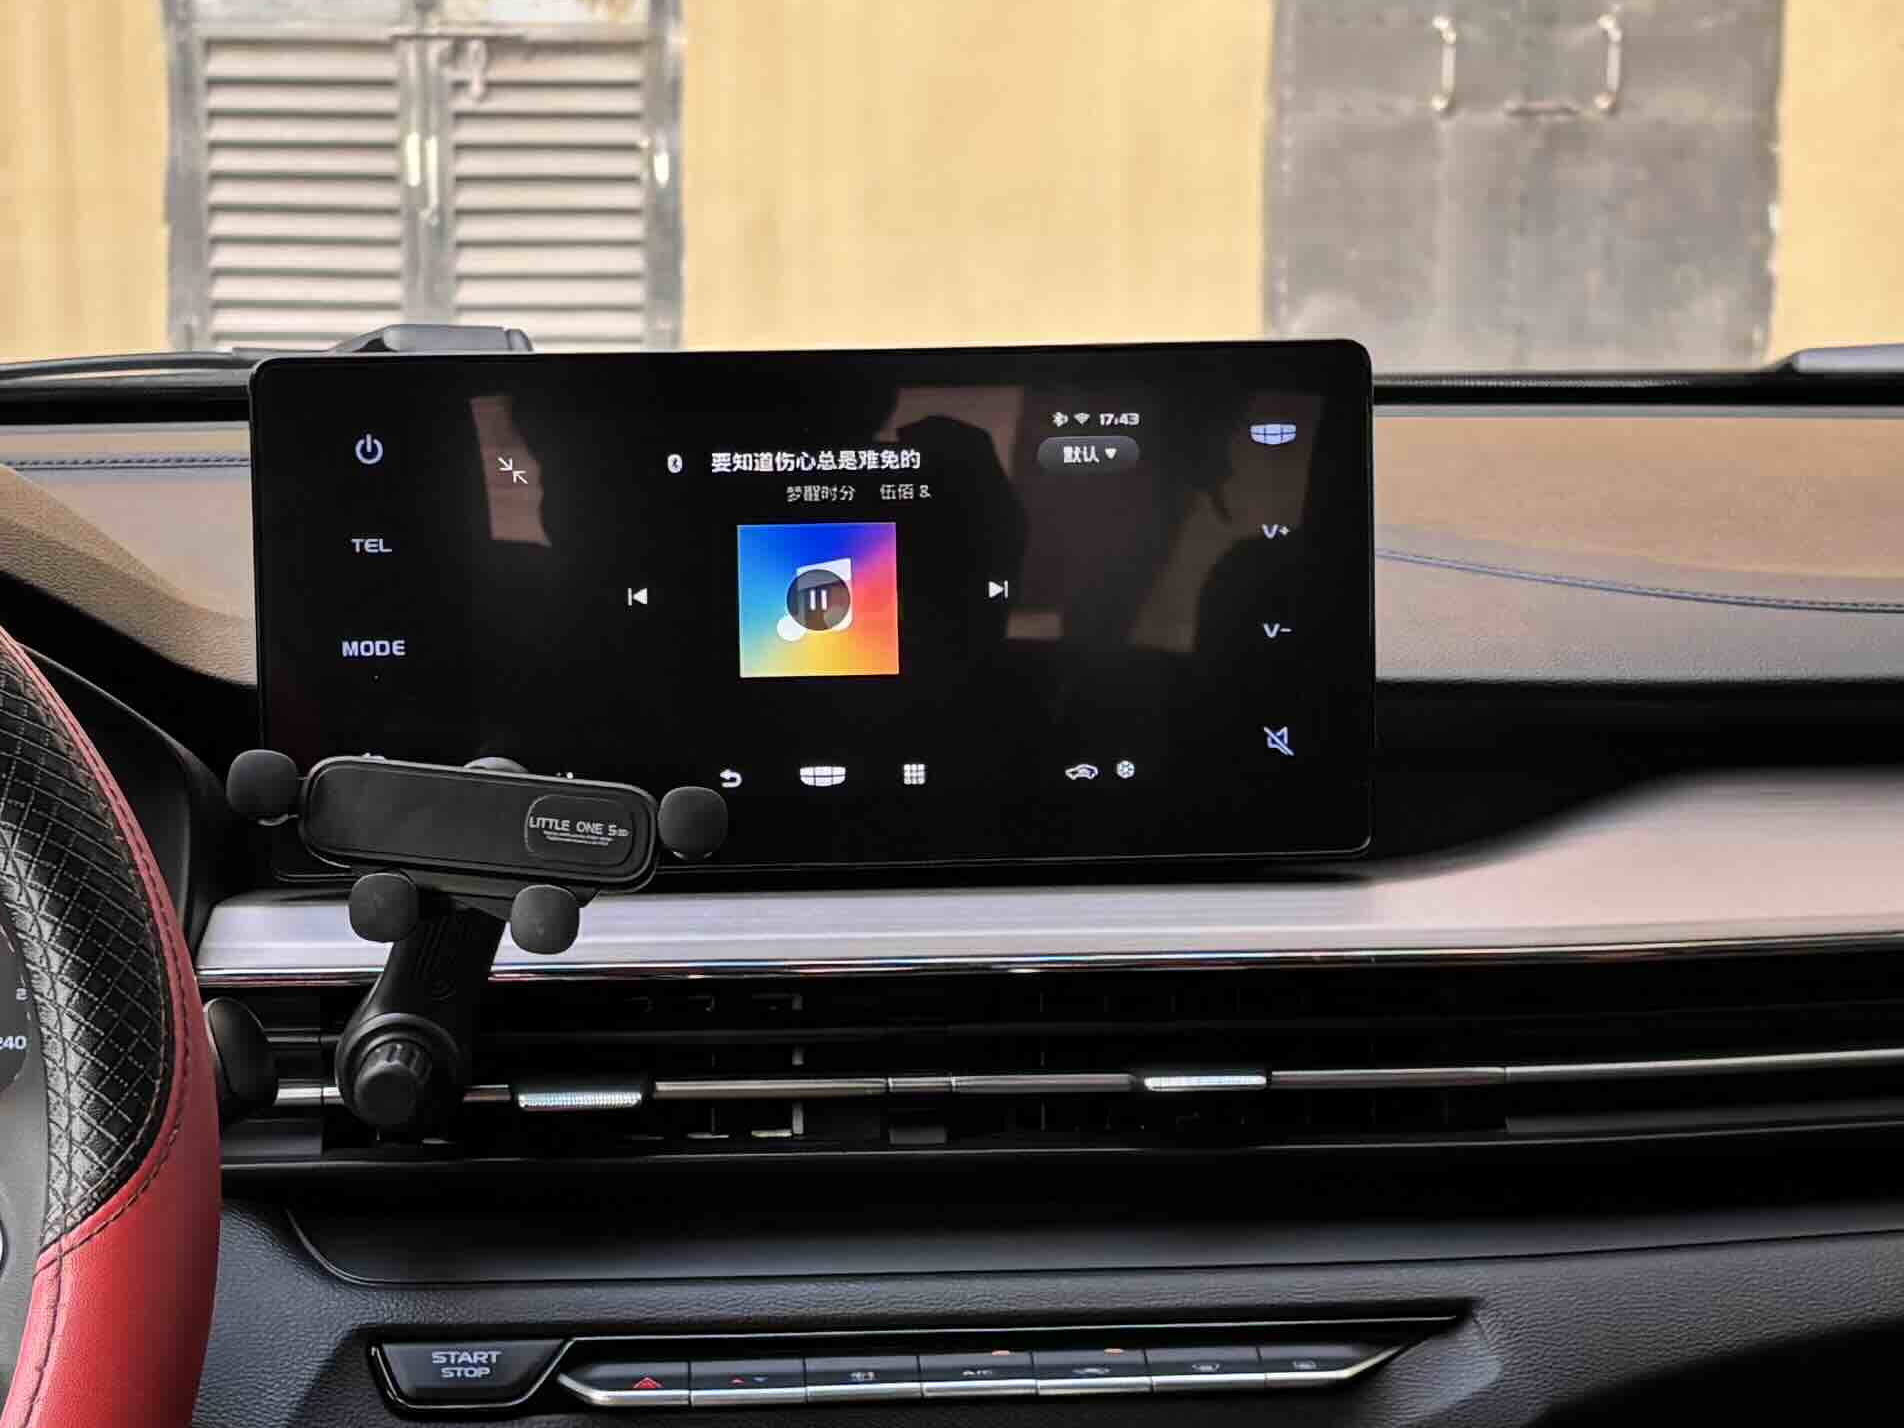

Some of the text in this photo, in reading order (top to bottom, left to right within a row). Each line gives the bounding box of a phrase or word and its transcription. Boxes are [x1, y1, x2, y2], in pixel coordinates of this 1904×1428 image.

[1099, 412, 1140, 426] 17:43
[710, 450, 921, 472] 要知道伤心总是难免的
[1063, 446, 1100, 464] 默认
[786, 484, 856, 502] 梦醒时分
[1262, 523, 1290, 539] V+
[352, 537, 392, 554] TEL
[342, 639, 406, 658] MODE
[529, 816, 570, 831] LITTLE
[576, 821, 604, 835] ONE
[431, 1351, 503, 1365] START
[440, 1366, 491, 1379] STOP
